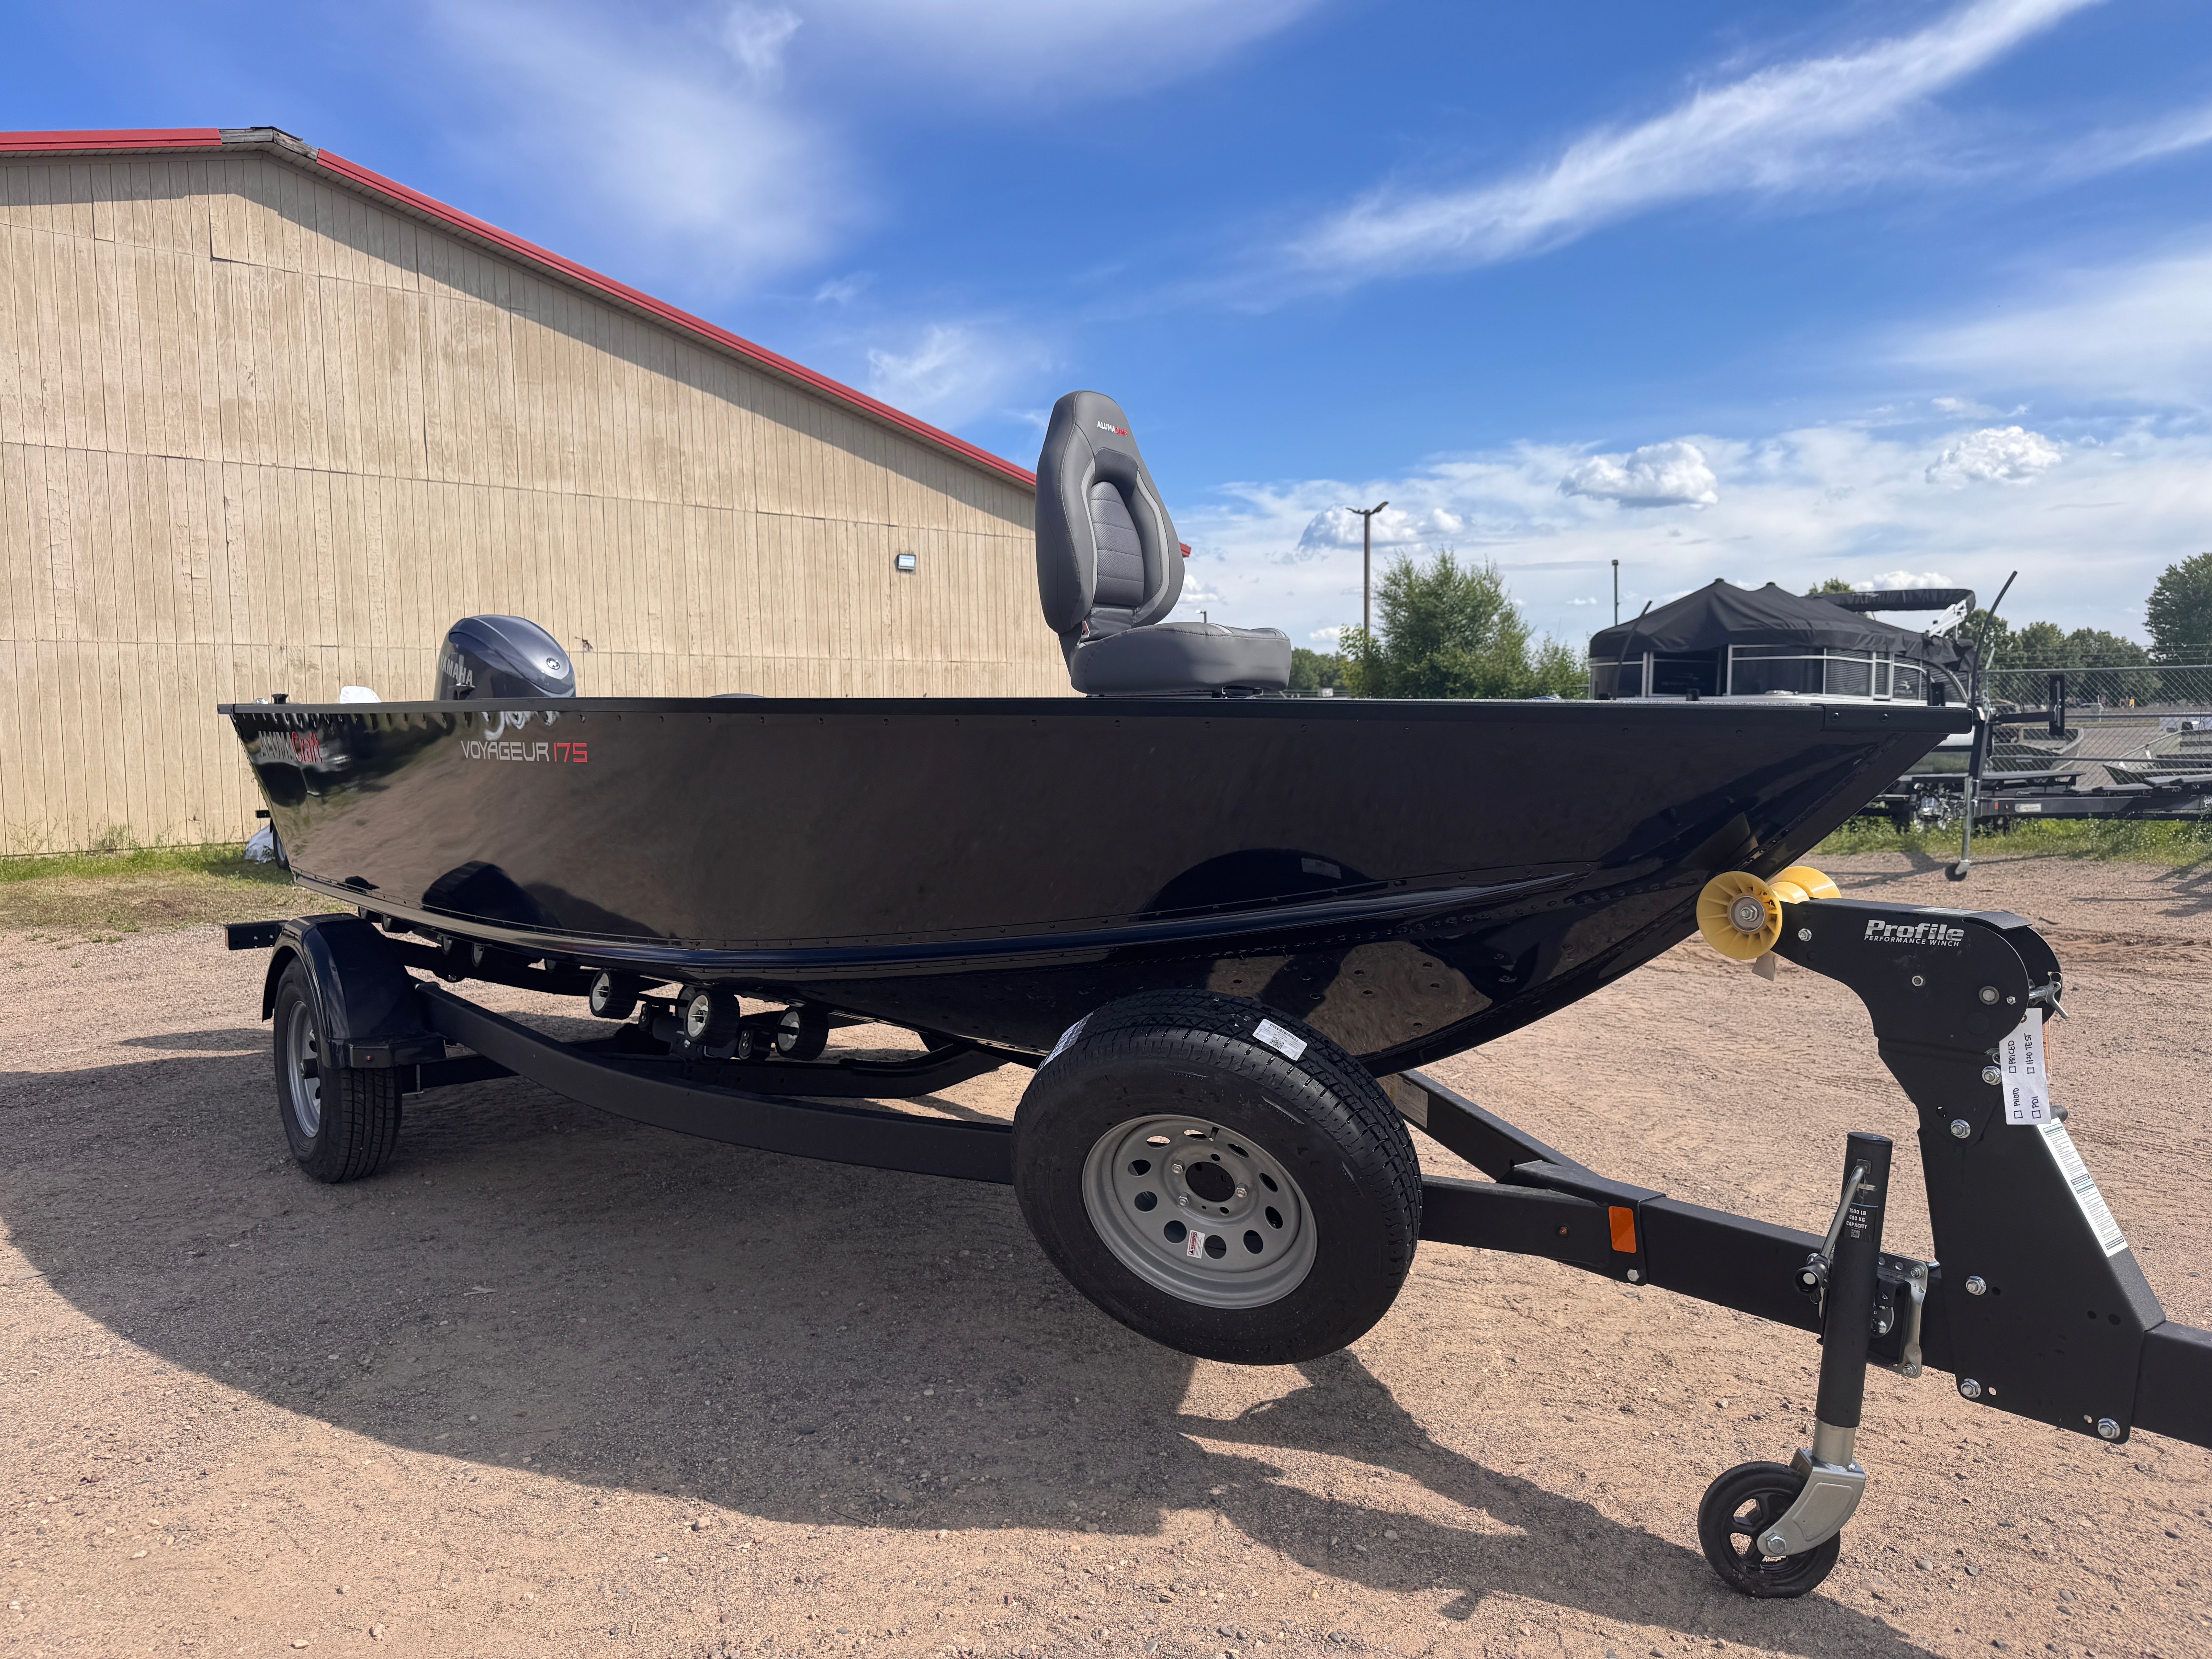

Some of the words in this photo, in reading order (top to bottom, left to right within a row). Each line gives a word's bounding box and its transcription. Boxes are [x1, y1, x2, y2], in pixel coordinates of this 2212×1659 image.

[440, 653, 473, 686] YAMAHA
[258, 730, 322, 763] ALUMACraft
[460, 740, 550, 762] VOYAGEUR
[554, 743, 587, 762] 175
[1864, 935, 1926, 945] PERFORMANCE
[1865, 919, 1964, 941] Profile
[2008, 1040, 2016, 1064] PRICED
[2024, 1033, 2032, 1050] TEST
[2013, 1087, 2021, 1107] PHOTO
[1846, 1221, 1867, 1229] CAPACITY
